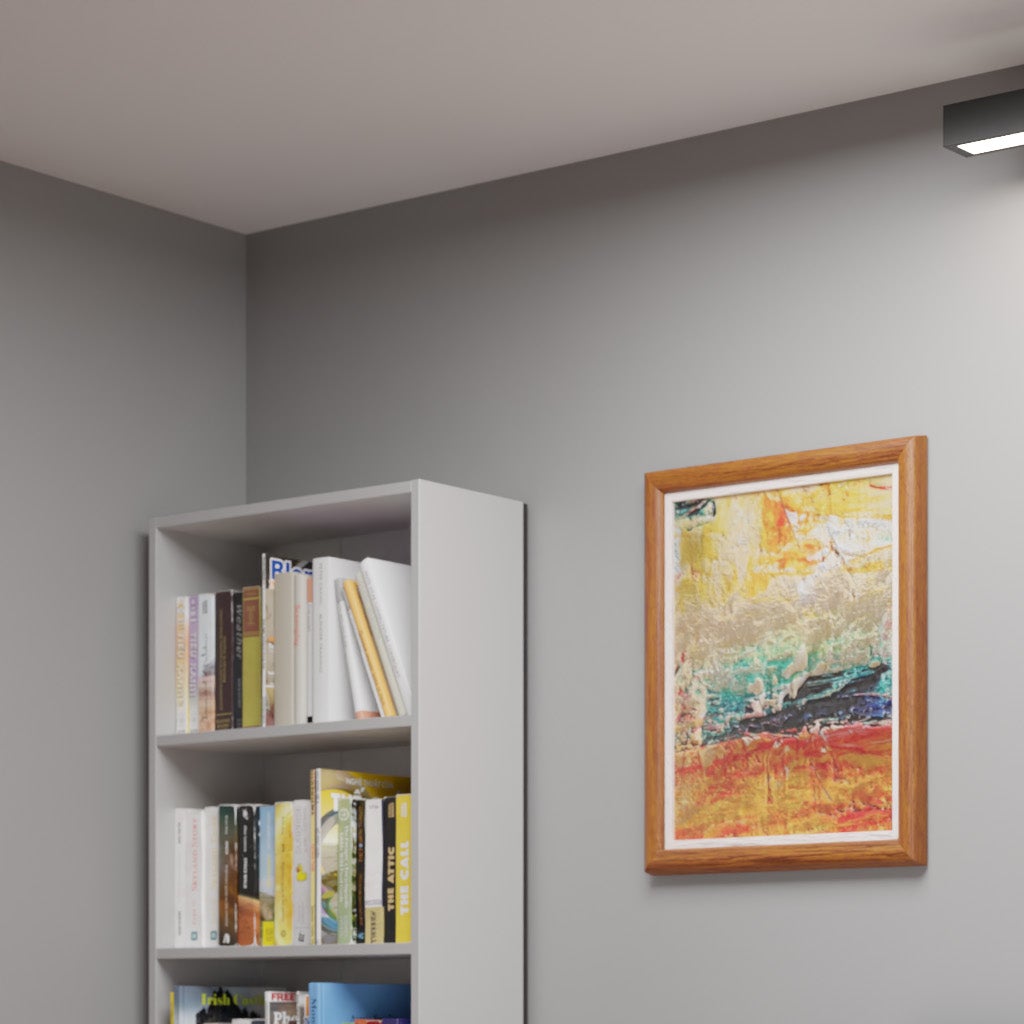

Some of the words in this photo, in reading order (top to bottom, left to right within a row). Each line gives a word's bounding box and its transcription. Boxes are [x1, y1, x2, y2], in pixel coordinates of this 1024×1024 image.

[387, 846, 396, 887] ATTIC
[400, 841, 409, 882] CALL
[387, 888, 395, 913] THE
[400, 886, 409, 916] THE
[201, 993, 231, 1007] Irish
[272, 992, 296, 1002] FREE
